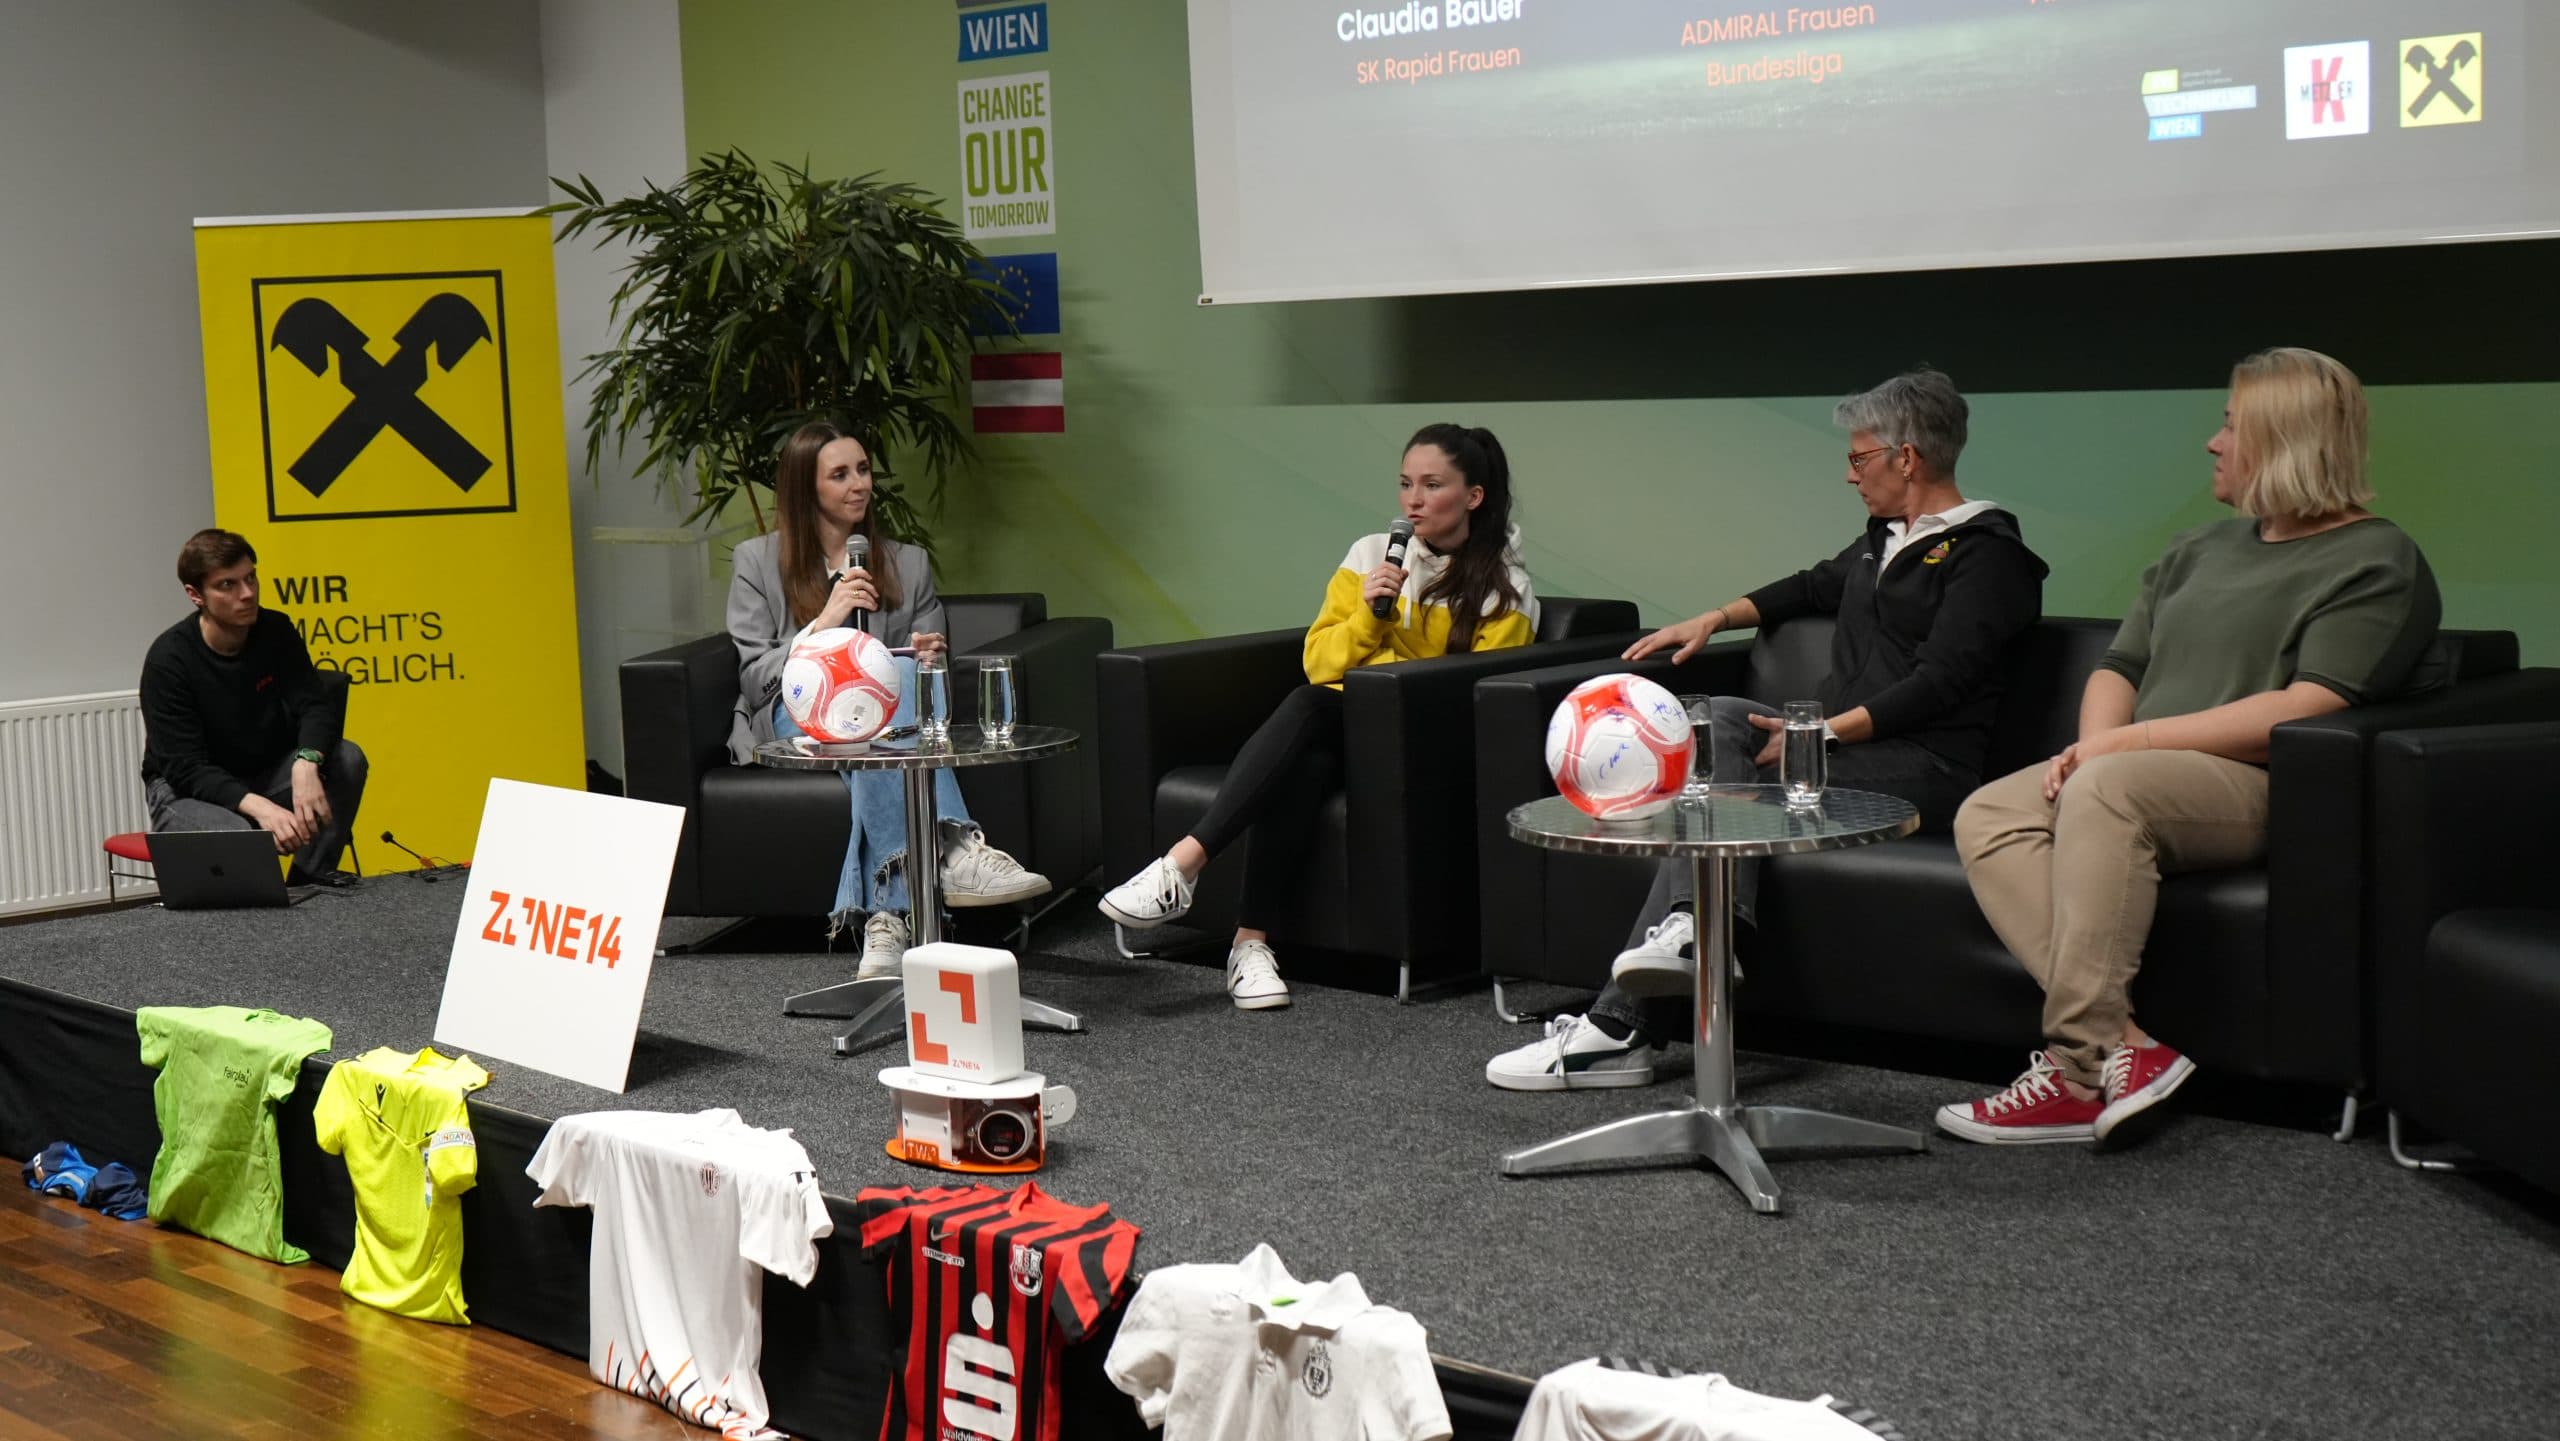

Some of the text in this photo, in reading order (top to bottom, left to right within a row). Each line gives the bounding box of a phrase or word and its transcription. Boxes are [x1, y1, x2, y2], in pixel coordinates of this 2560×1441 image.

[967, 11, 1039, 53] WIEN
[1337, 0, 1523, 42] Claudia Bauer
[1681, 4, 1876, 47] ADMIRAL Frauen
[1357, 47, 1521, 85] SK Rapid Frauen
[1706, 51, 1842, 87] Bundesliga
[963, 82, 1046, 124] CHANGE
[965, 126, 1048, 197] OUR
[968, 200, 1050, 229] TOMORROW
[273, 575, 348, 605] WIR
